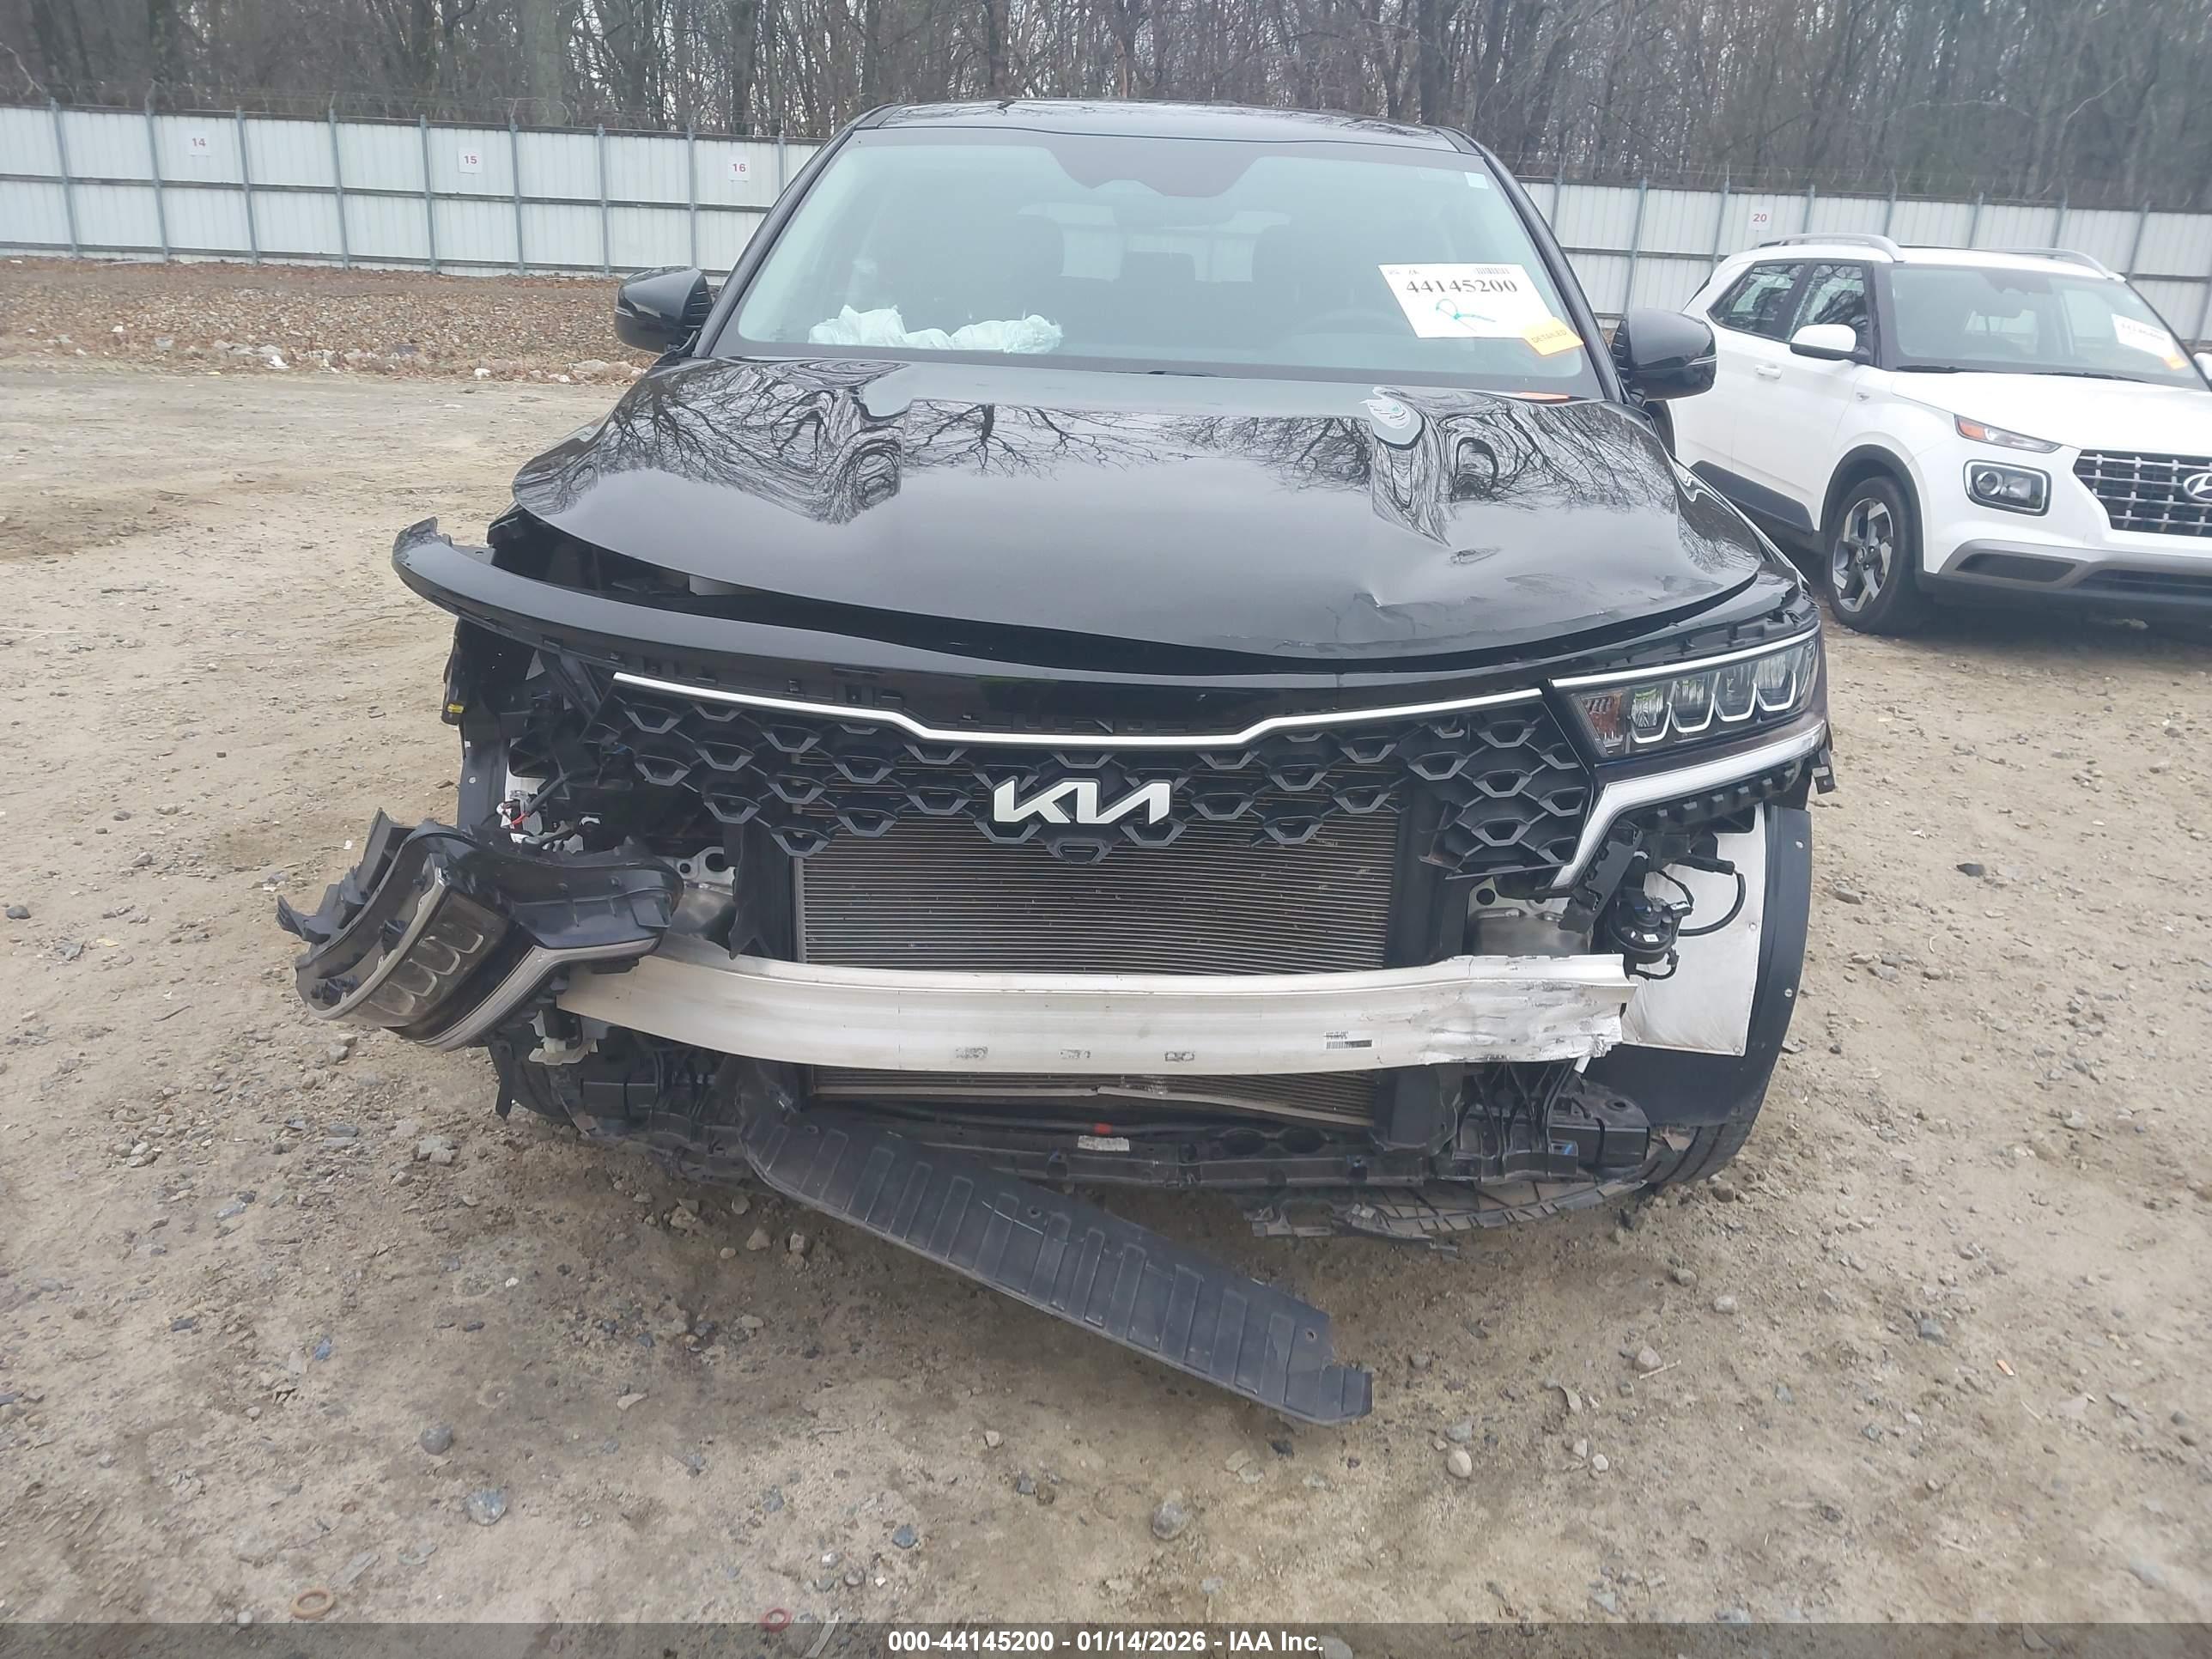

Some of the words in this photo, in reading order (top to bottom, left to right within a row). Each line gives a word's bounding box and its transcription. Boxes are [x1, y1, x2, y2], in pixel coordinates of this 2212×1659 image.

[191, 137, 207, 147] 14
[464, 155, 477, 164] 15
[732, 163, 746, 173] 16
[1753, 213, 1767, 222] 20
[1406, 279, 1518, 293] 44145200
[994, 779, 1171, 825] KIA
